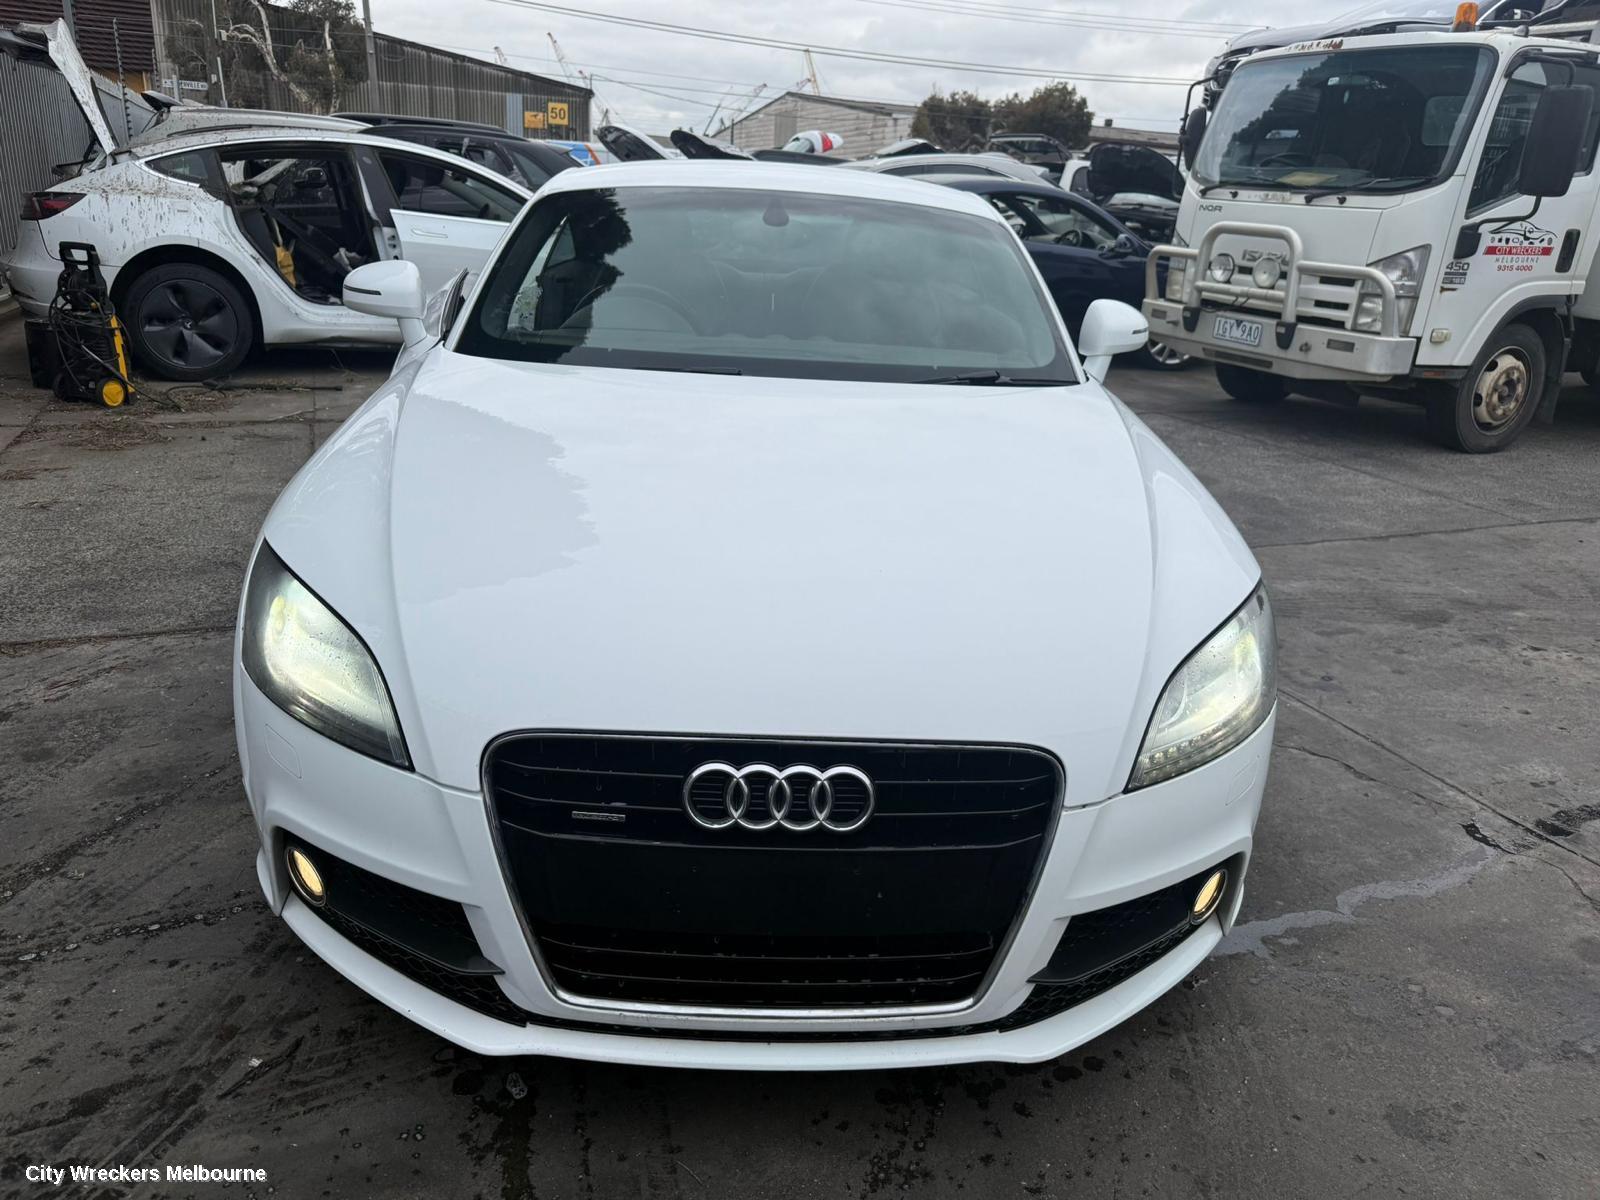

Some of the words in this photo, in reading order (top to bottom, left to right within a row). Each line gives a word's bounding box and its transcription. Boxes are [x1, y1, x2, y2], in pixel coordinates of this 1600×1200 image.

[550, 106, 566, 120] 50
[1496, 246, 1510, 255] CITY
[1511, 246, 1543, 255] WRECKERS
[1446, 261, 1470, 271] 450
[1497, 264, 1514, 272] 9315
